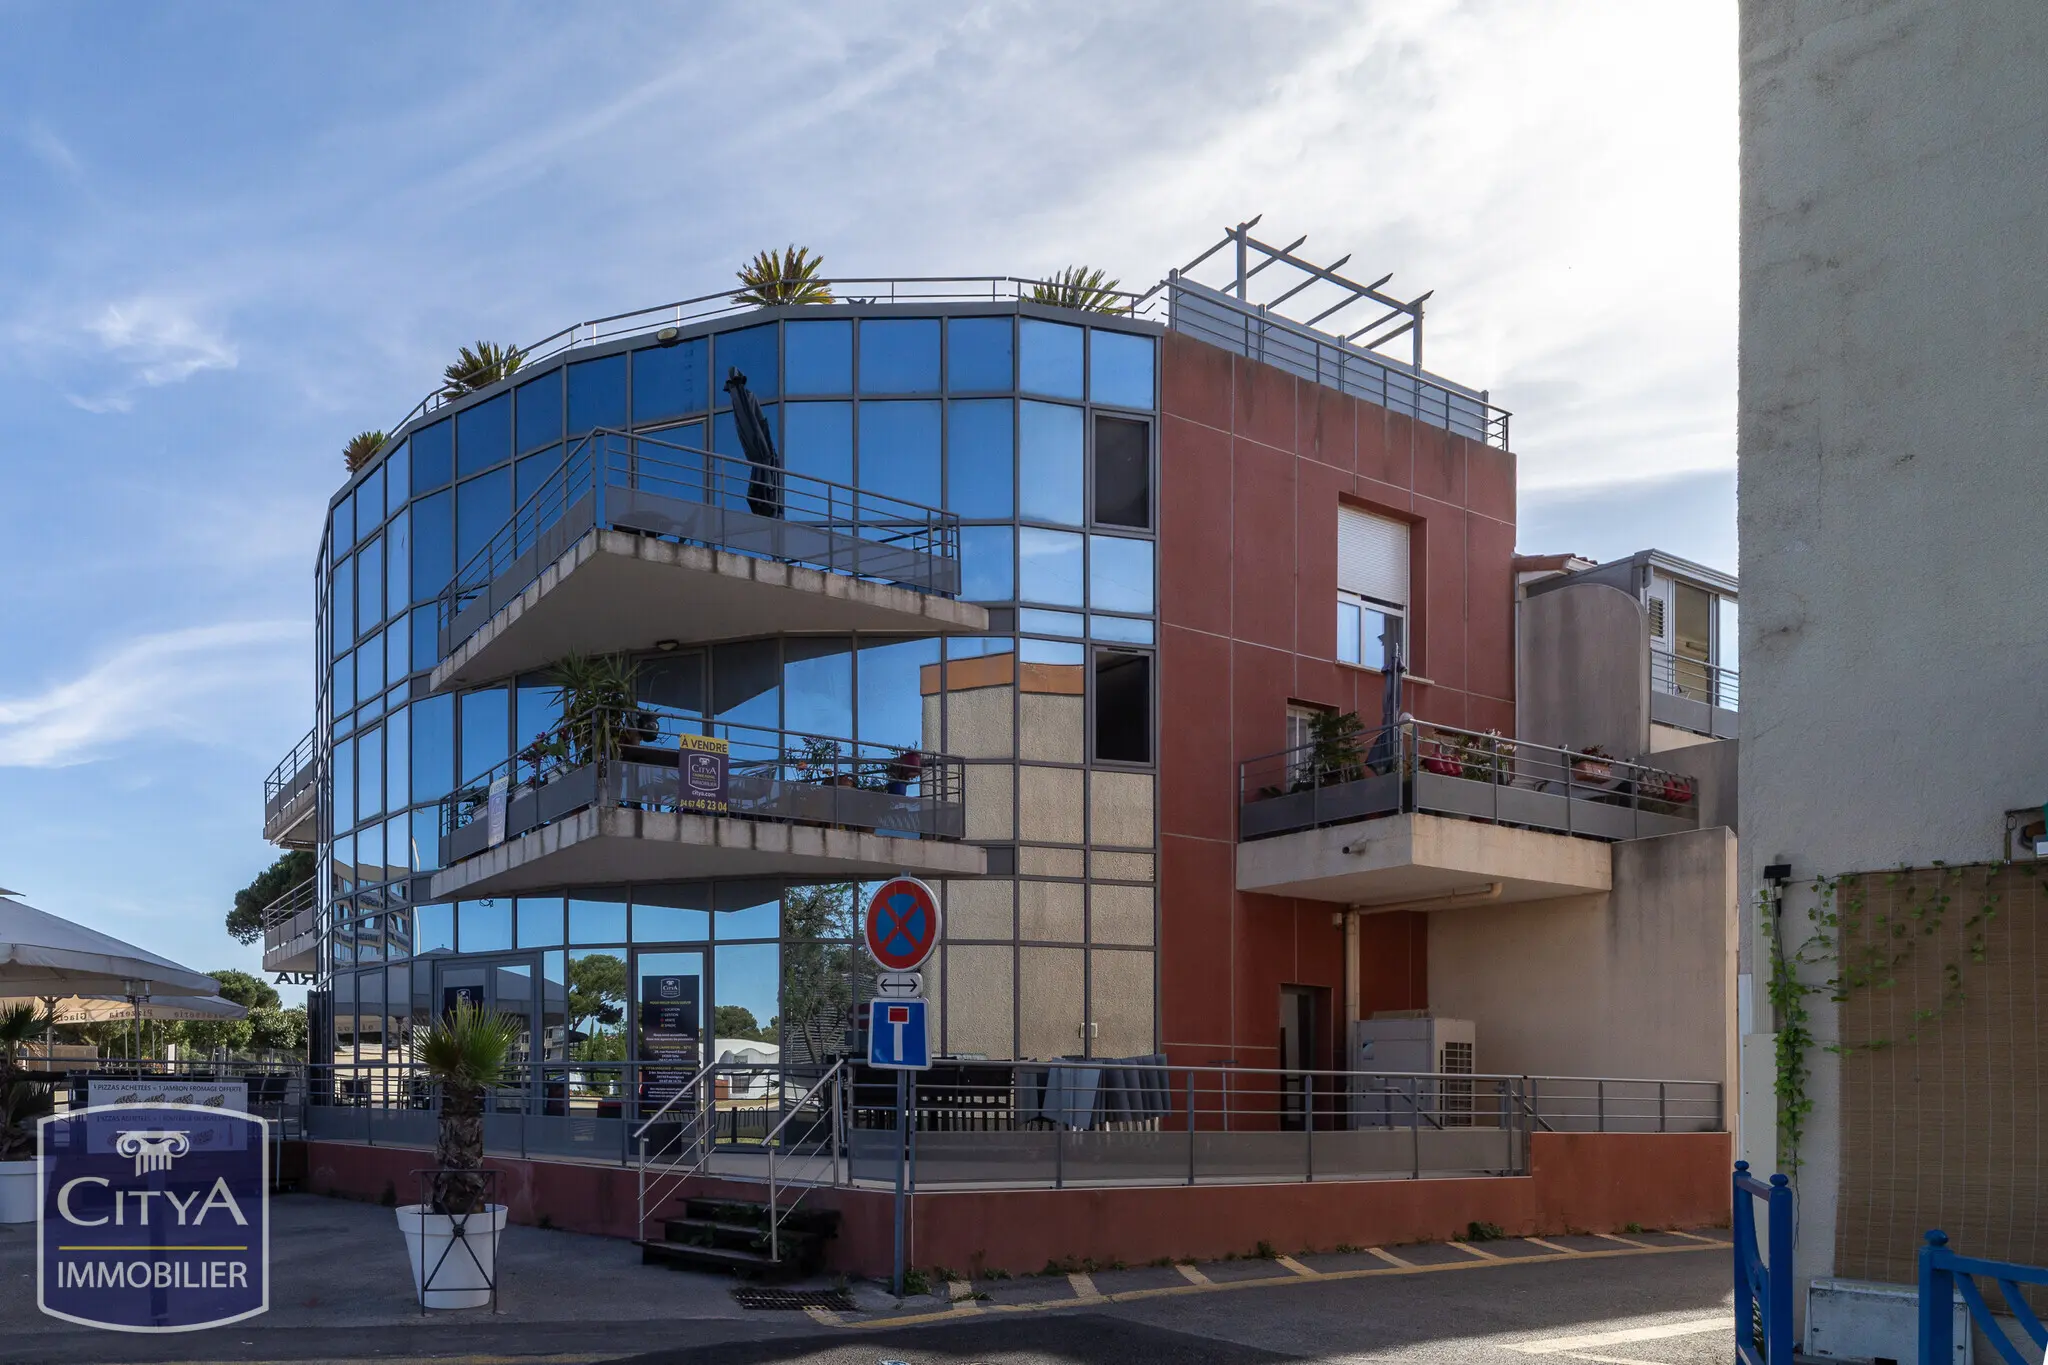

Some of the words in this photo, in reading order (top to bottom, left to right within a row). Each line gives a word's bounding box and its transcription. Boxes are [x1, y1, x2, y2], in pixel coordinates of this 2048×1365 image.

[682, 735, 689, 747] À
[691, 740, 727, 752] VENDRE
[691, 790, 716, 798] citya.com
[696, 799, 705, 809] 46
[707, 800, 716, 811] 23
[717, 801, 727, 812] 04
